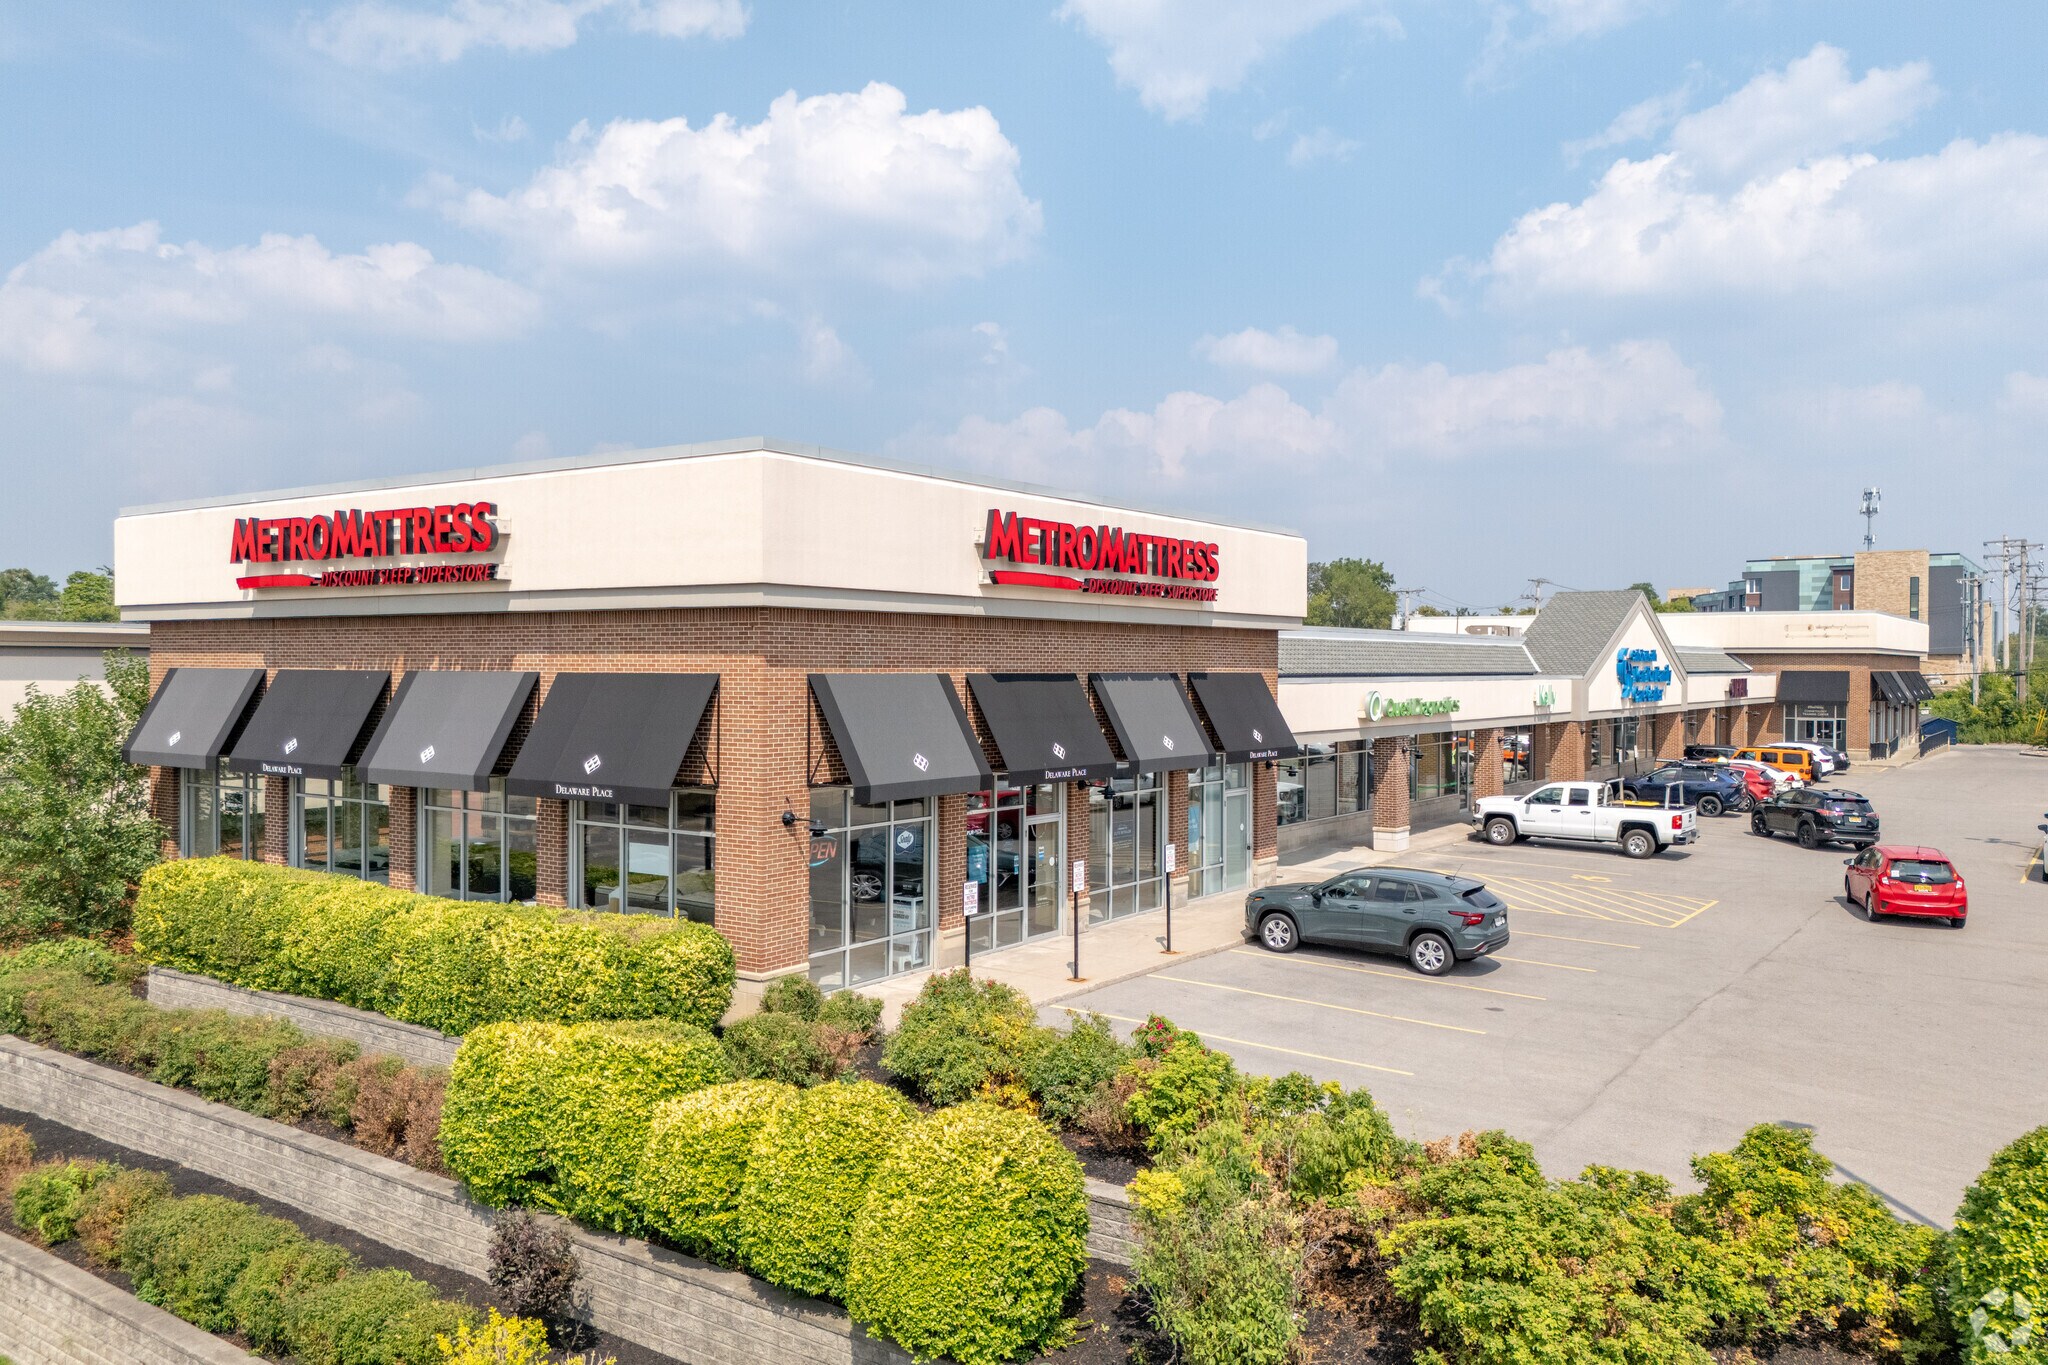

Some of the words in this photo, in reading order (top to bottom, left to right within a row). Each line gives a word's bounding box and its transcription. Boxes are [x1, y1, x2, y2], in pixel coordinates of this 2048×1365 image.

[321, 569, 376, 587] DISCOUNT
[379, 566, 411, 585] SLEEP
[414, 563, 494, 583] SUPERSTORE
[1088, 578, 1138, 596] DISCOUNT
[1140, 582, 1166, 598] SLEEP
[1167, 585, 1219, 601] SUPERSTORE
[262, 763, 287, 773] DELAWARE
[287, 765, 302, 775] PLACE
[1045, 770, 1071, 779] DELAWARE
[1072, 768, 1087, 776] PLACE
[555, 784, 590, 796] DELAWARE
[592, 786, 613, 798] PLACE
[810, 841, 838, 859] PEN
